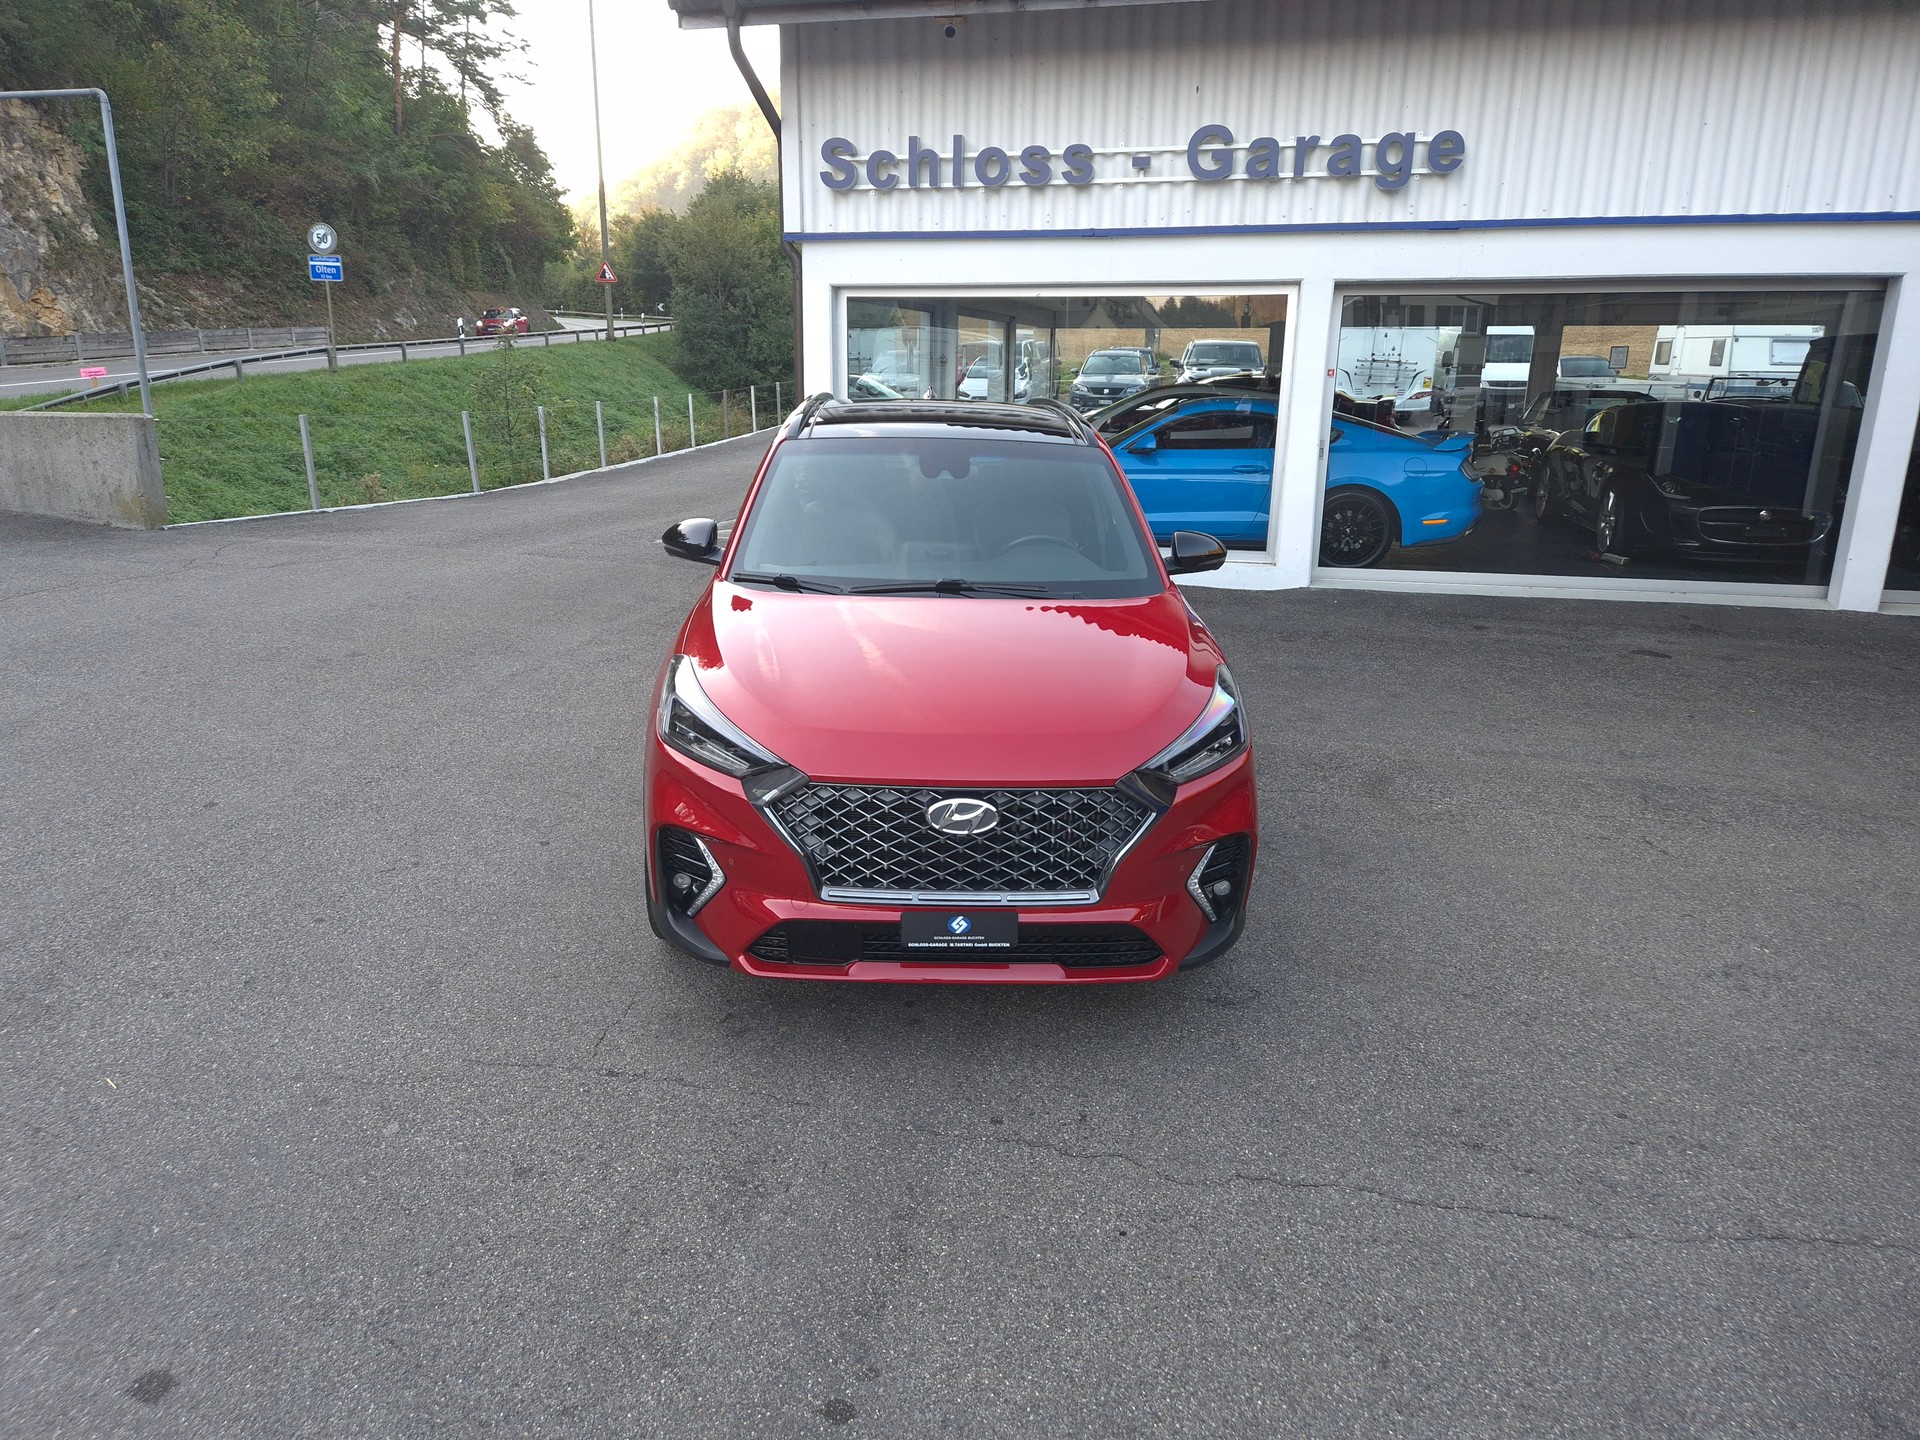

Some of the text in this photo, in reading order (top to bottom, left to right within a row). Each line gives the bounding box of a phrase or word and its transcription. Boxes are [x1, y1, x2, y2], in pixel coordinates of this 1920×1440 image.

[819, 135, 1094, 191] Schloss
[1186, 124, 1466, 191] Garage
[316, 233, 328, 244] 50
[315, 265, 337, 274] Olten
